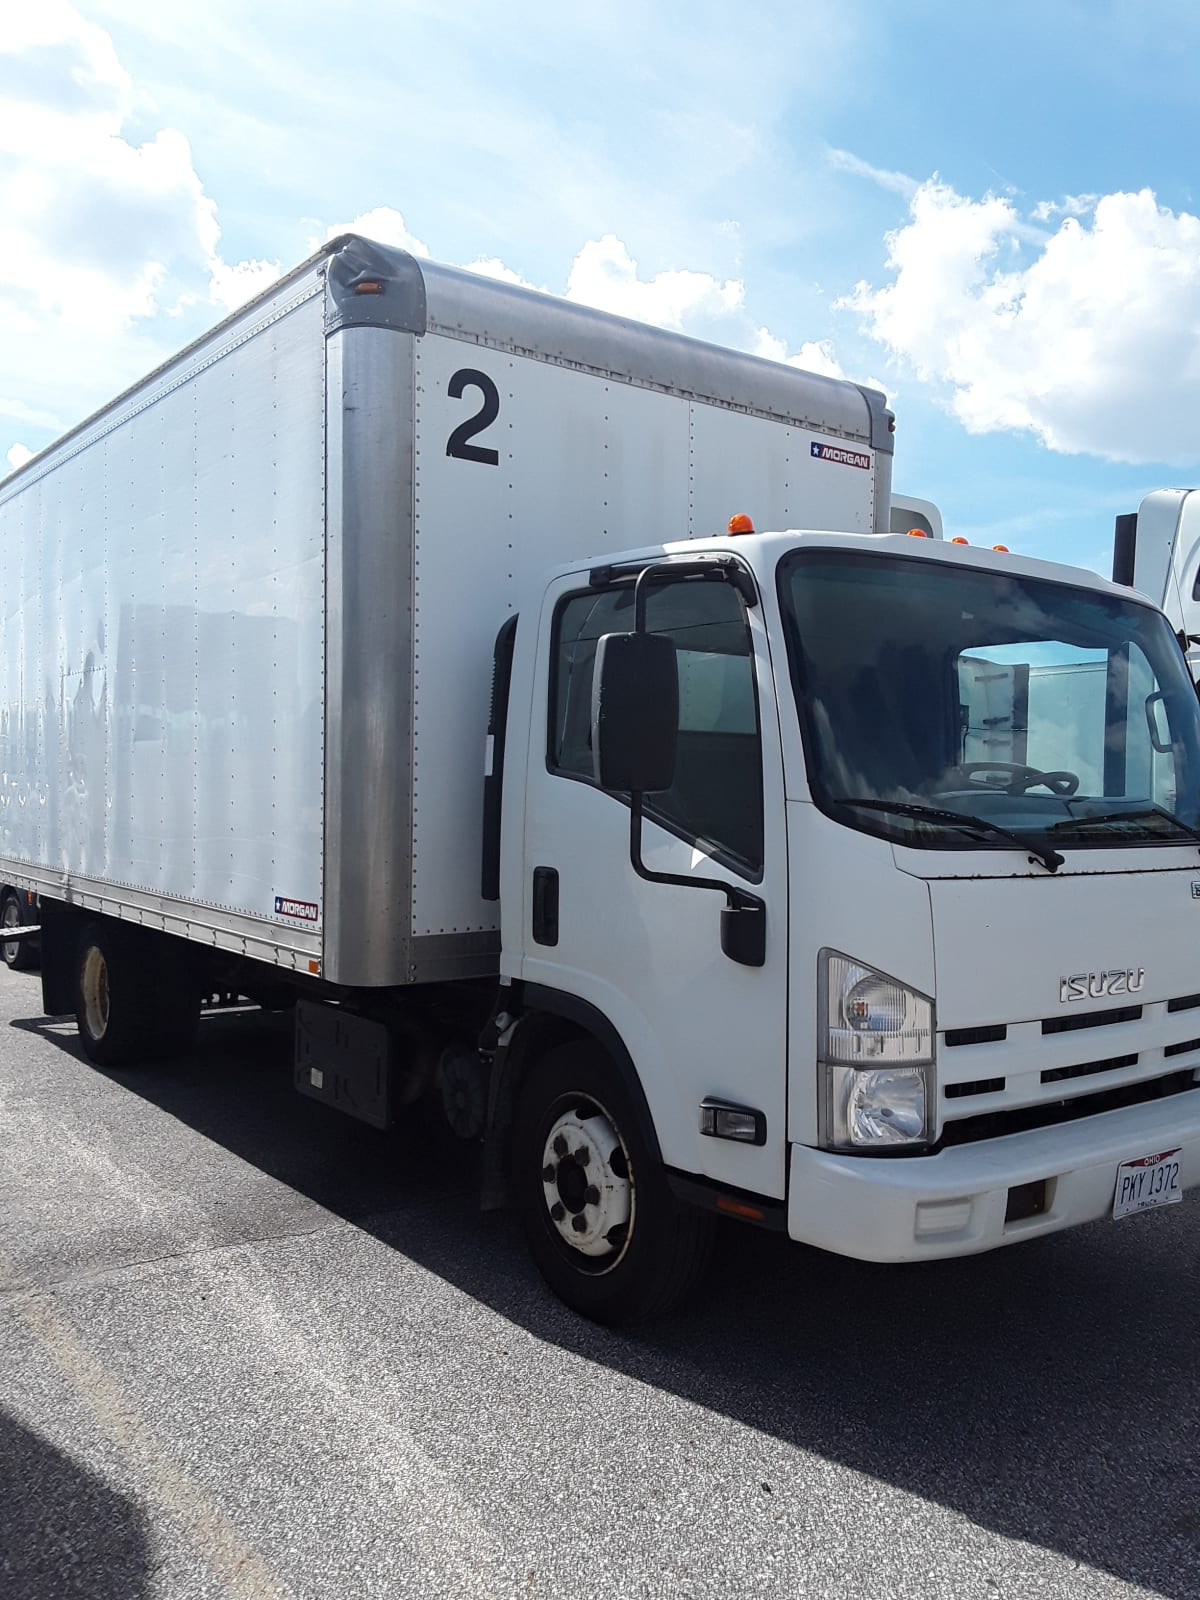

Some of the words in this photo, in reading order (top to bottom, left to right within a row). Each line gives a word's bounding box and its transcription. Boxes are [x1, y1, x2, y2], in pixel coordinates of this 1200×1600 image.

[446, 368, 500, 466] 2
[822, 447, 868, 468] MORGAN
[281, 900, 317, 919] MORGAN
[1060, 968, 1145, 1003] ISUZU
[1144, 1155, 1161, 1166] OHIO
[1121, 1172, 1146, 1205] PKY
[1148, 1162, 1179, 1196] 1372
